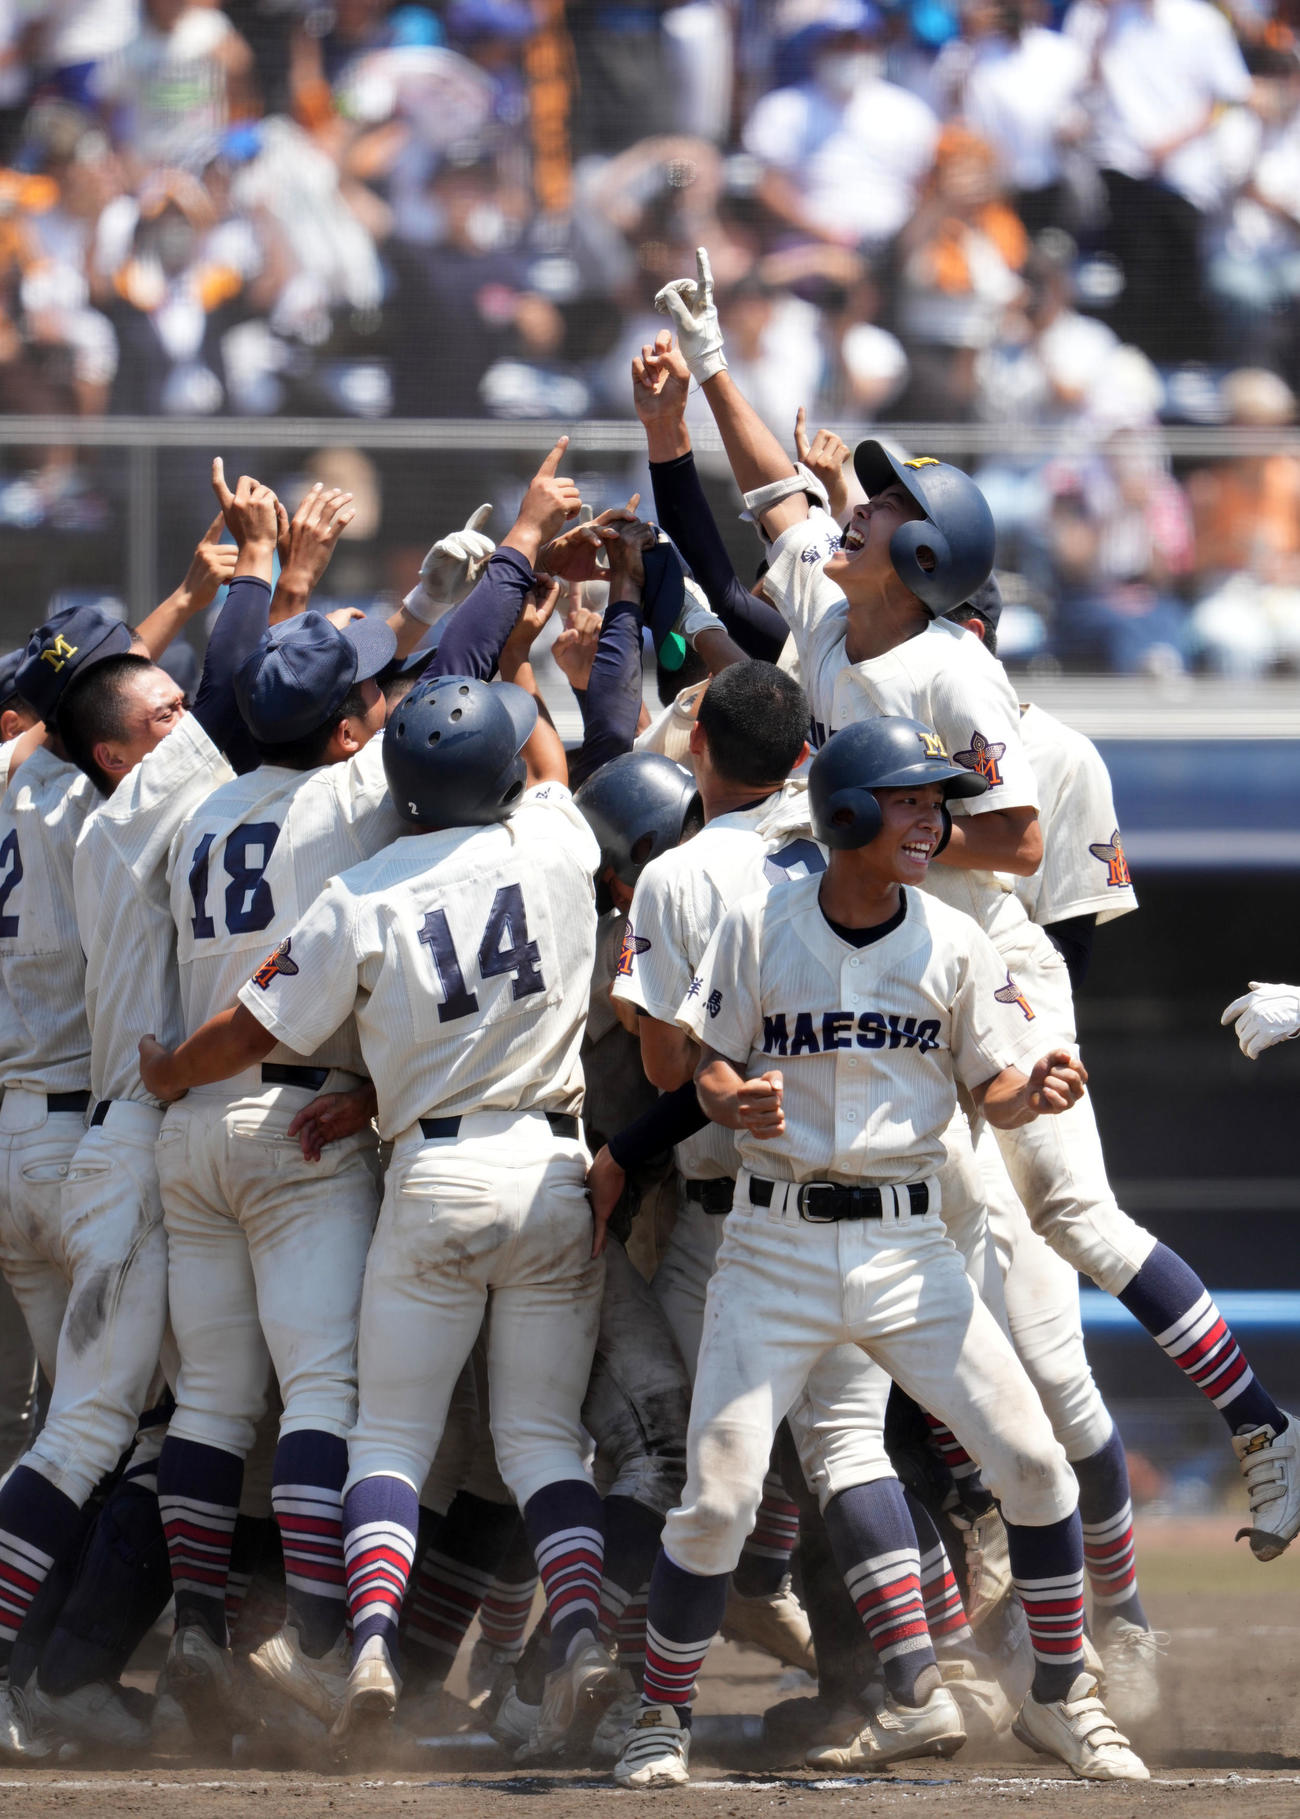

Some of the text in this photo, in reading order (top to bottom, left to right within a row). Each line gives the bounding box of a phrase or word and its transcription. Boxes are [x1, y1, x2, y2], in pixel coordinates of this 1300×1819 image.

[40, 634, 79, 673] M
[919, 732, 949, 760] M
[408, 801, 420, 815] 2
[188, 821, 281, 940] 18
[417, 882, 547, 1024] 14
